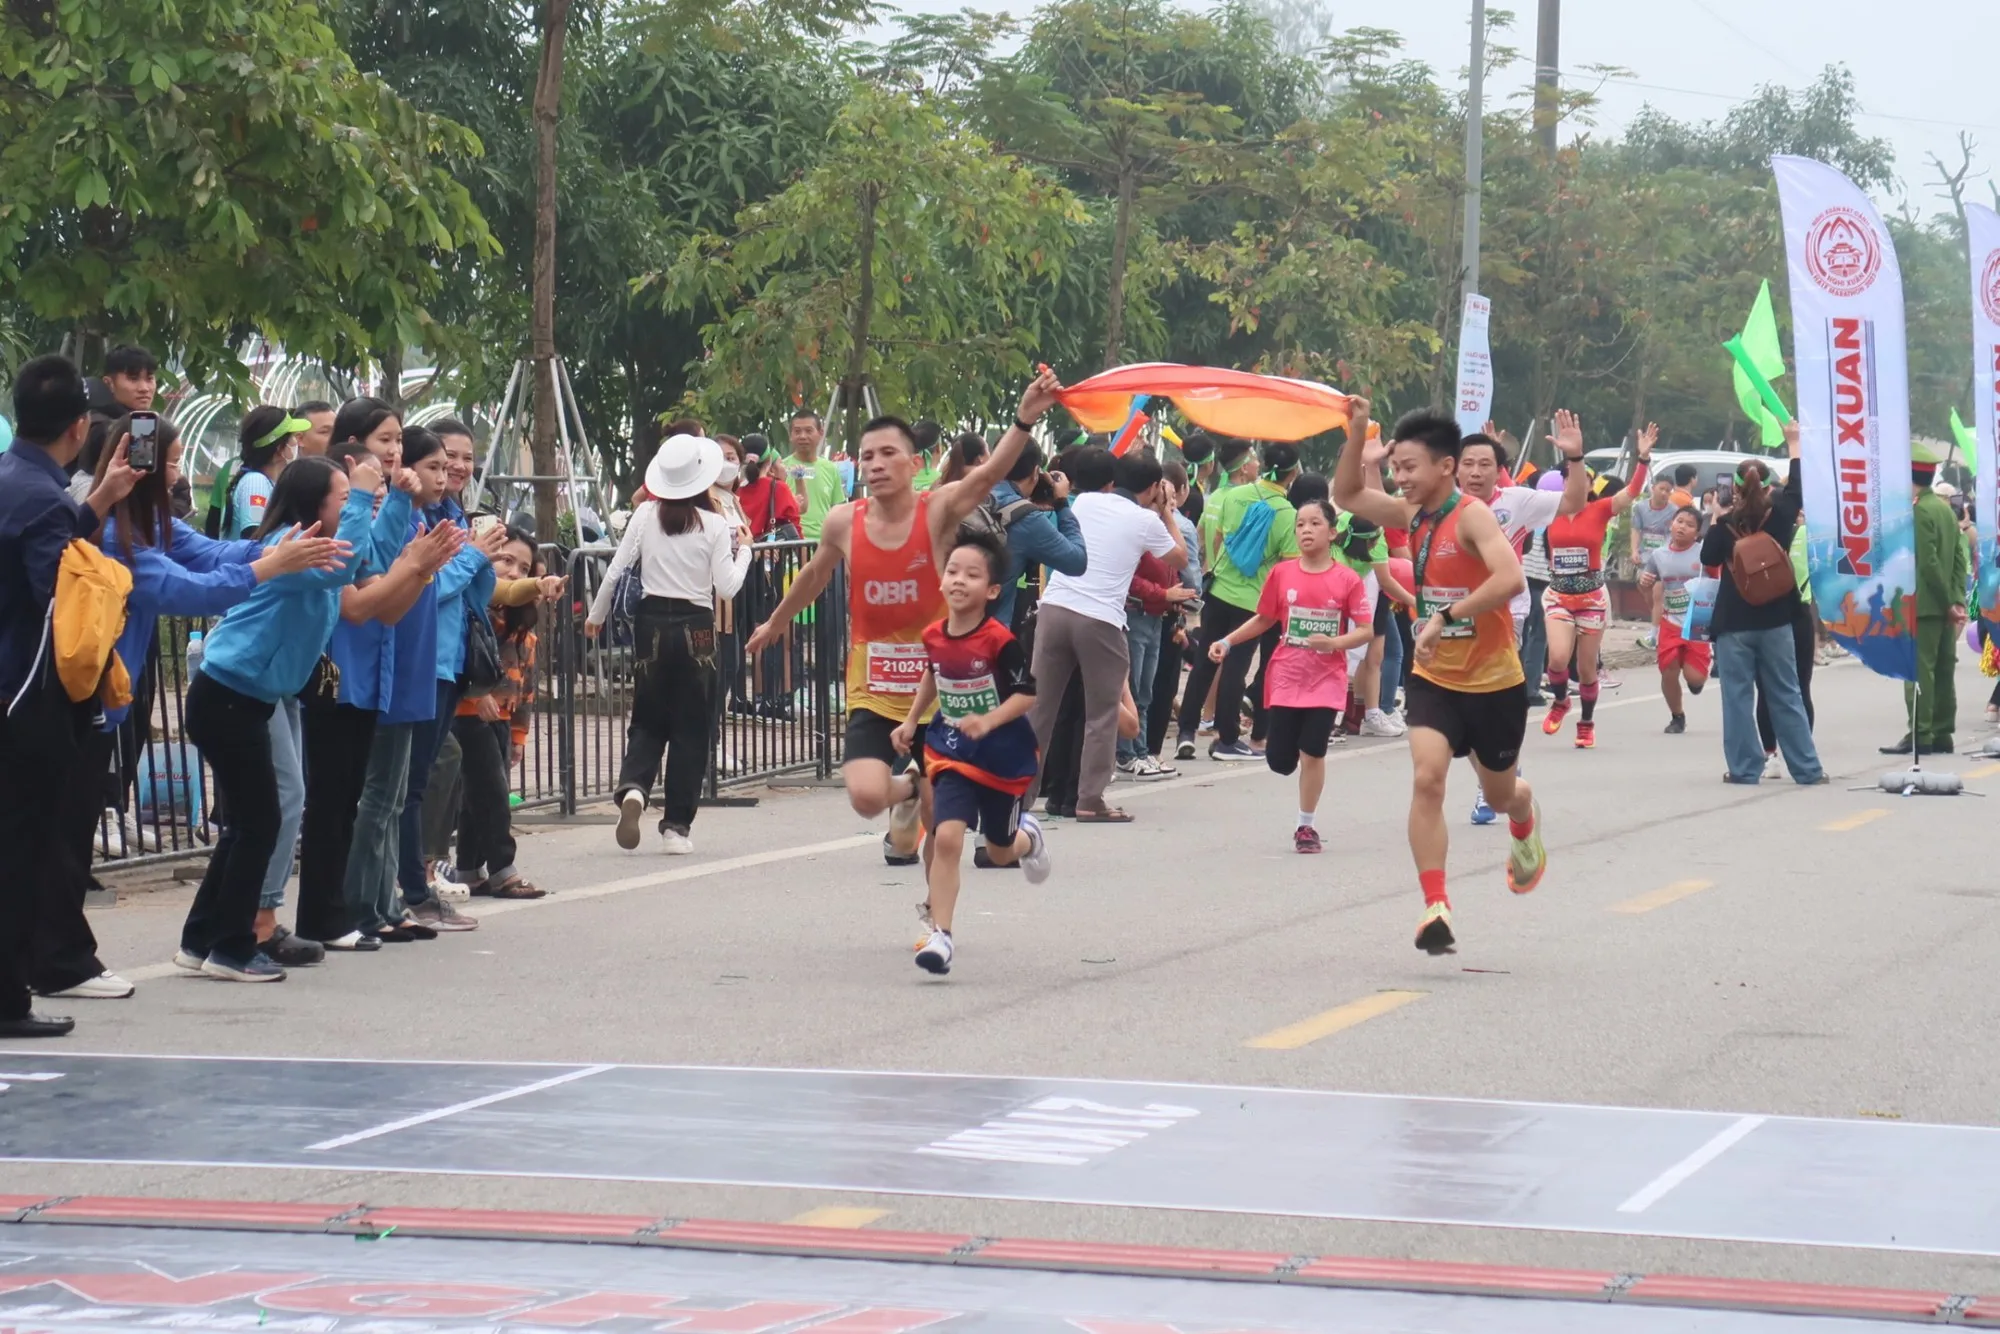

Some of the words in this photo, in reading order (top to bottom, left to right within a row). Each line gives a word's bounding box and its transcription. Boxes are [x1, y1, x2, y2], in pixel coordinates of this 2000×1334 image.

[1832, 318, 1866, 448] XUAN
[1836, 458, 1873, 577] NGHI
[864, 579, 918, 605] QBR
[1299, 620, 1332, 632] 50296
[882, 660, 924, 673] 21024
[946, 694, 984, 709] 50311
